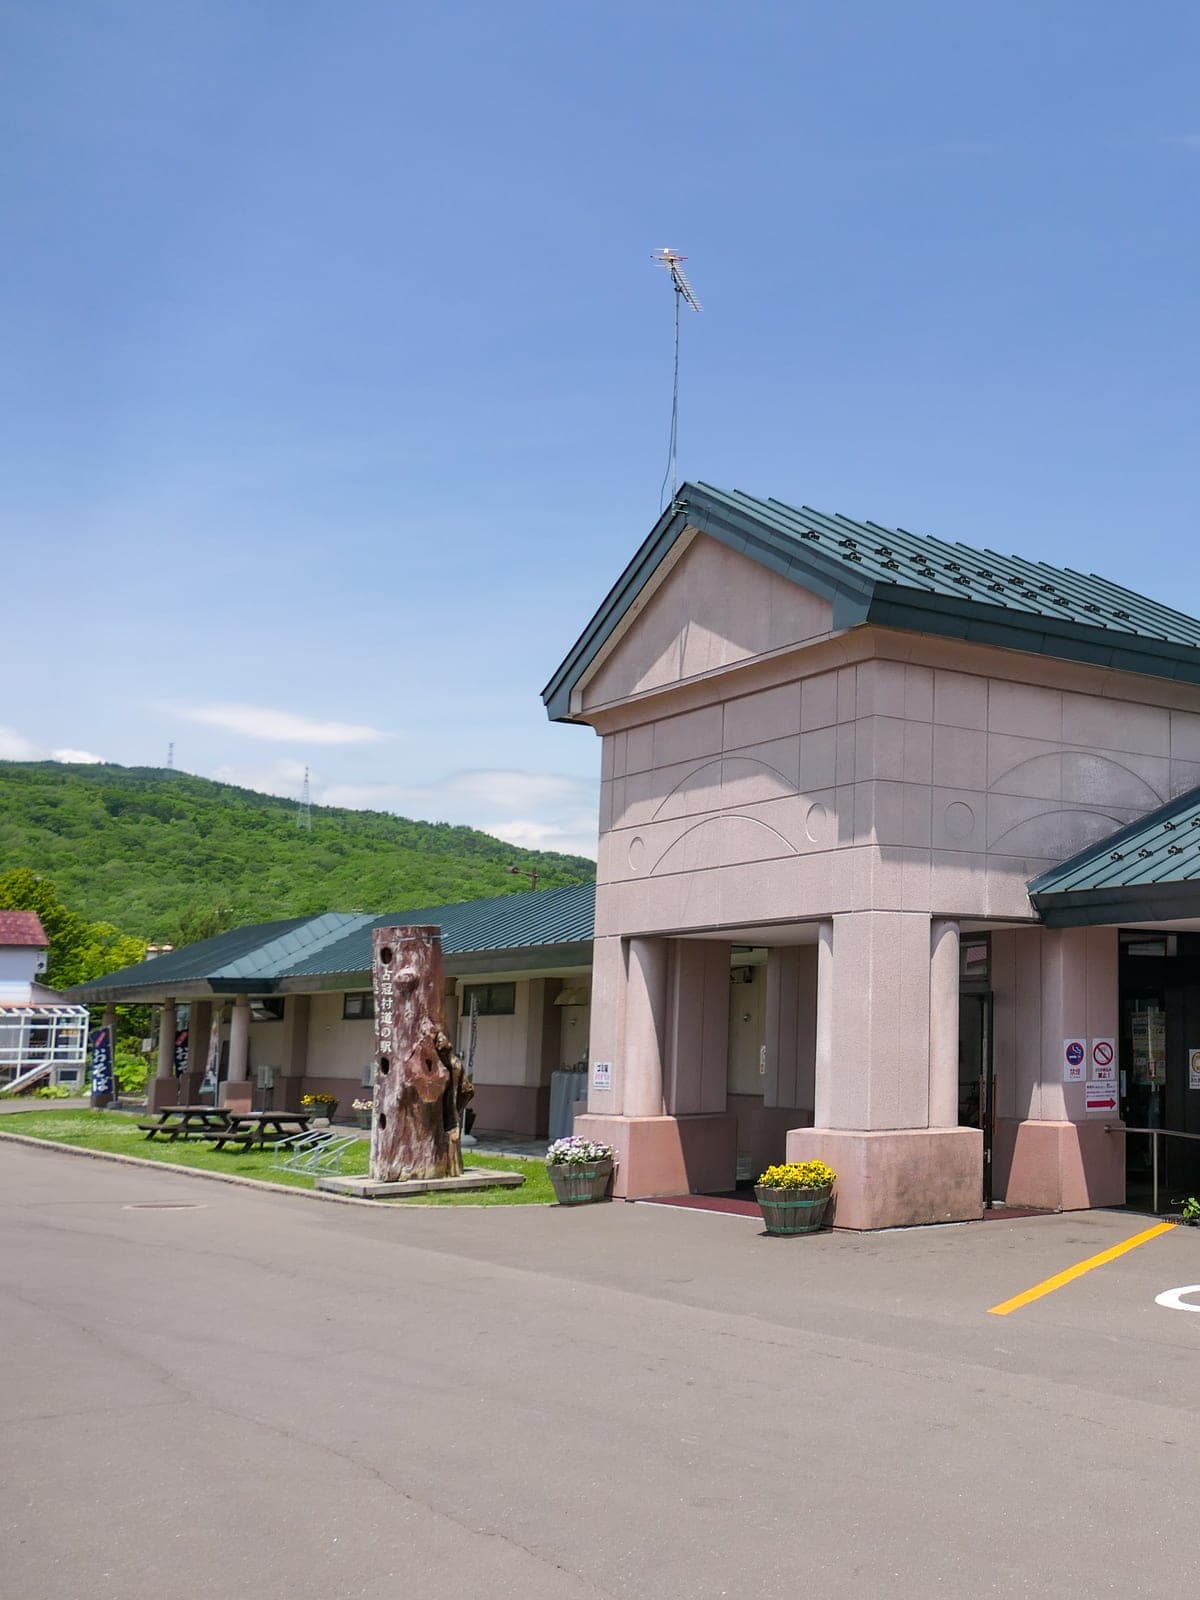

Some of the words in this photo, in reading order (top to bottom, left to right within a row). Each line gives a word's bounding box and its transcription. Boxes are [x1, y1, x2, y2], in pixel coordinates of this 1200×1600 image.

[381, 968, 393, 1052] 占冠村道の駅
[92, 1048, 110, 1092] おそば
